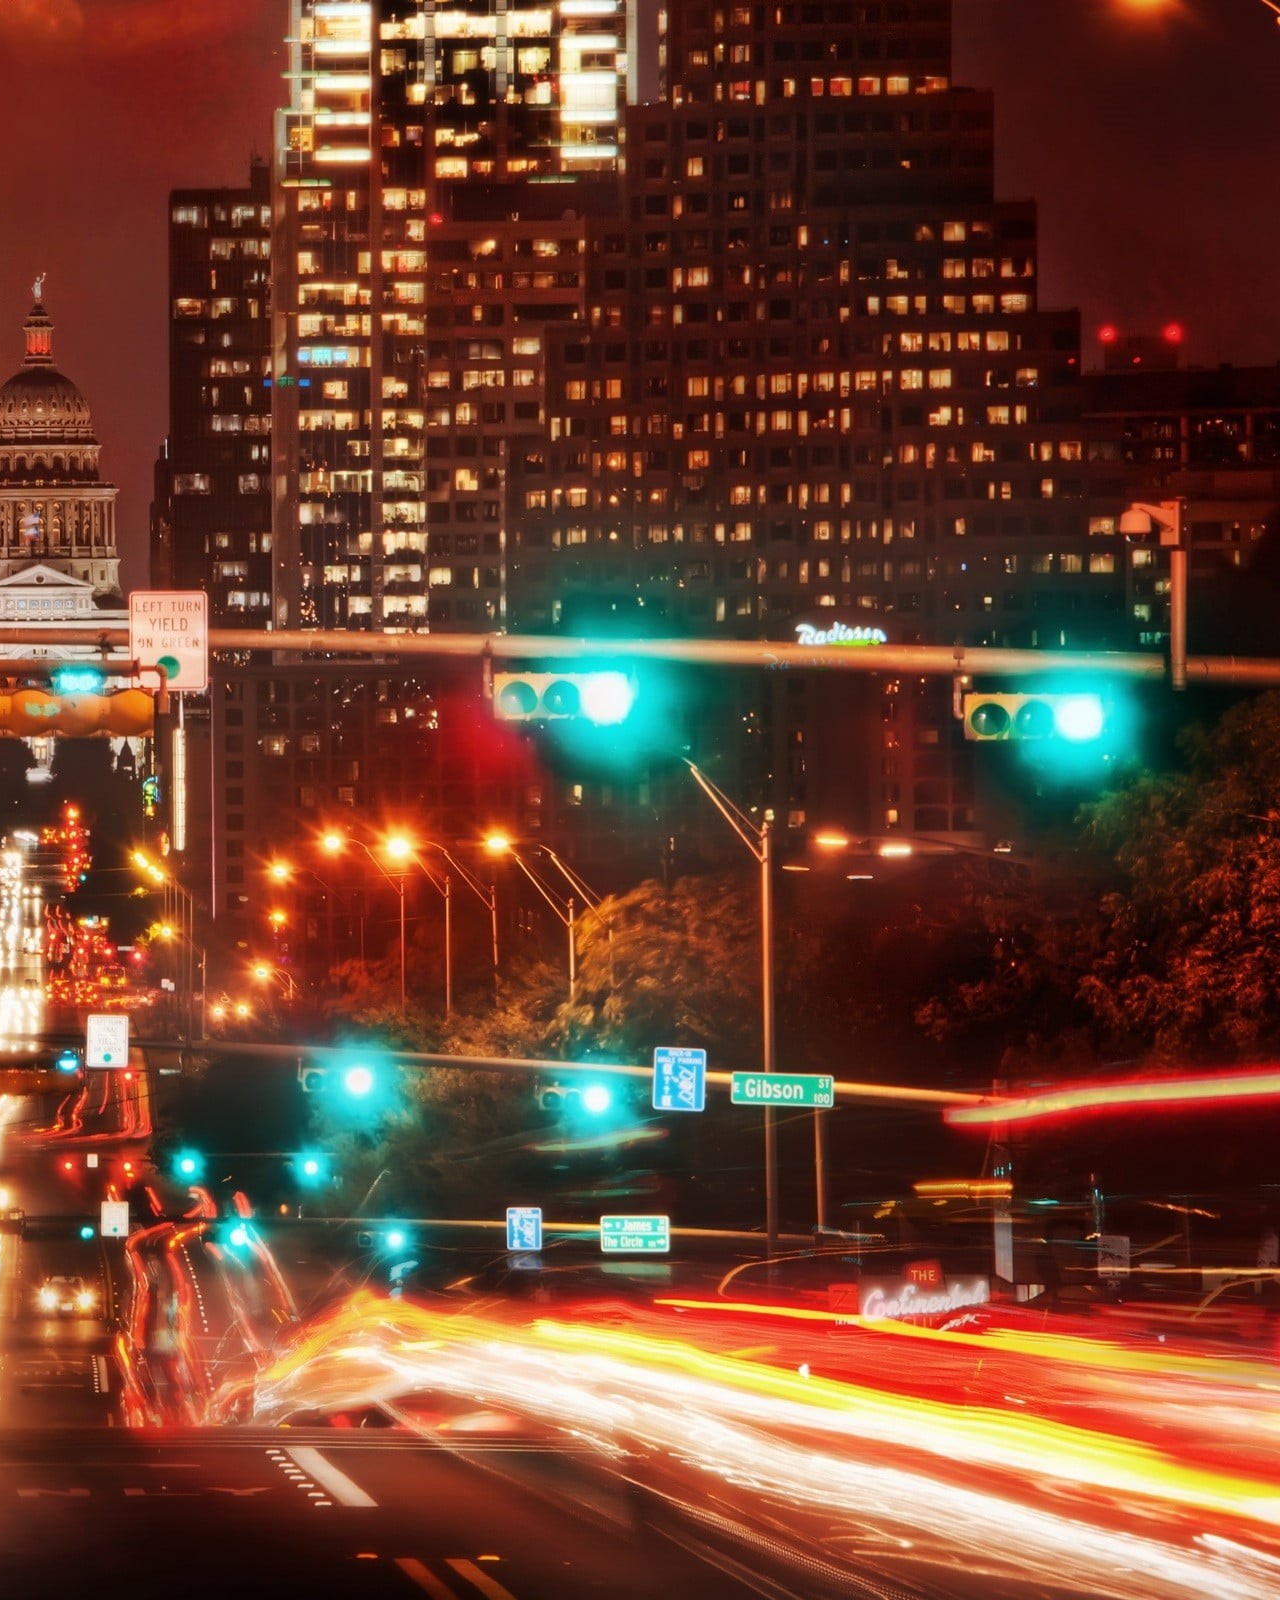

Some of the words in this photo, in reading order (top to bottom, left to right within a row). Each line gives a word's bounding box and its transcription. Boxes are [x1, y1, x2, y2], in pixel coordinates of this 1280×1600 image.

[135, 601, 163, 612] LEFT
[171, 601, 201, 612] TURN
[149, 617, 188, 632] YIELD
[795, 621, 887, 645] Radisson
[138, 638, 153, 648] ON
[161, 637, 199, 648] GREEN
[734, 1081, 740, 1094] E
[744, 1078, 804, 1100] Gibson
[818, 1078, 830, 1089] ST
[814, 1093, 830, 1104] 100
[622, 1219, 652, 1233] James
[603, 1236, 618, 1248] The
[620, 1236, 643, 1248] Circle
[911, 1269, 936, 1281] THE
[862, 1280, 987, 1322] Continental
